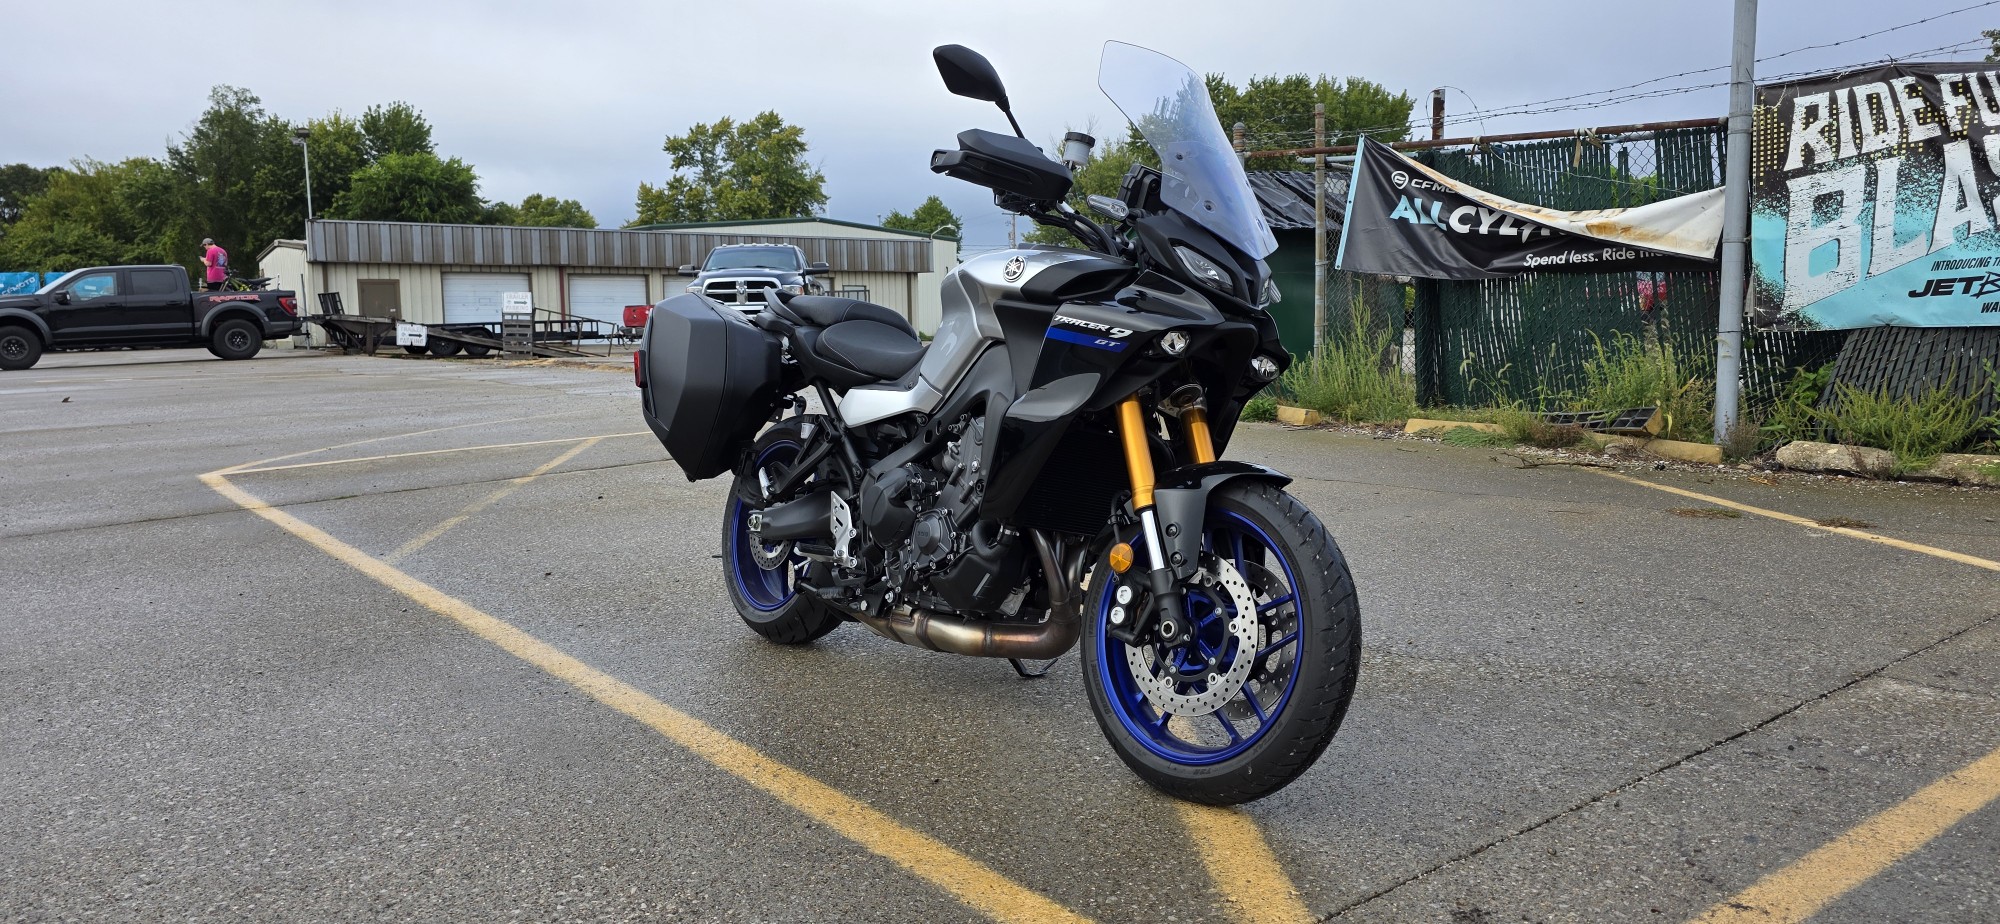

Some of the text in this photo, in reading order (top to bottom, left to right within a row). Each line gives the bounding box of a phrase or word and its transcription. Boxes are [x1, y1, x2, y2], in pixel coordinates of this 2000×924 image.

[1783, 76, 1942, 171] RIDE
[1389, 194, 1448, 231] ALL
[1523, 251, 1568, 268] Spend
[1569, 250, 1599, 264] less.
[1602, 248, 1636, 261] Ride
[1930, 256, 1992, 272] INTRODUCING
[209, 294, 261, 302] RAPTOR
[1054, 315, 1134, 339] TRACER 9
[1094, 339, 1121, 347] GT
